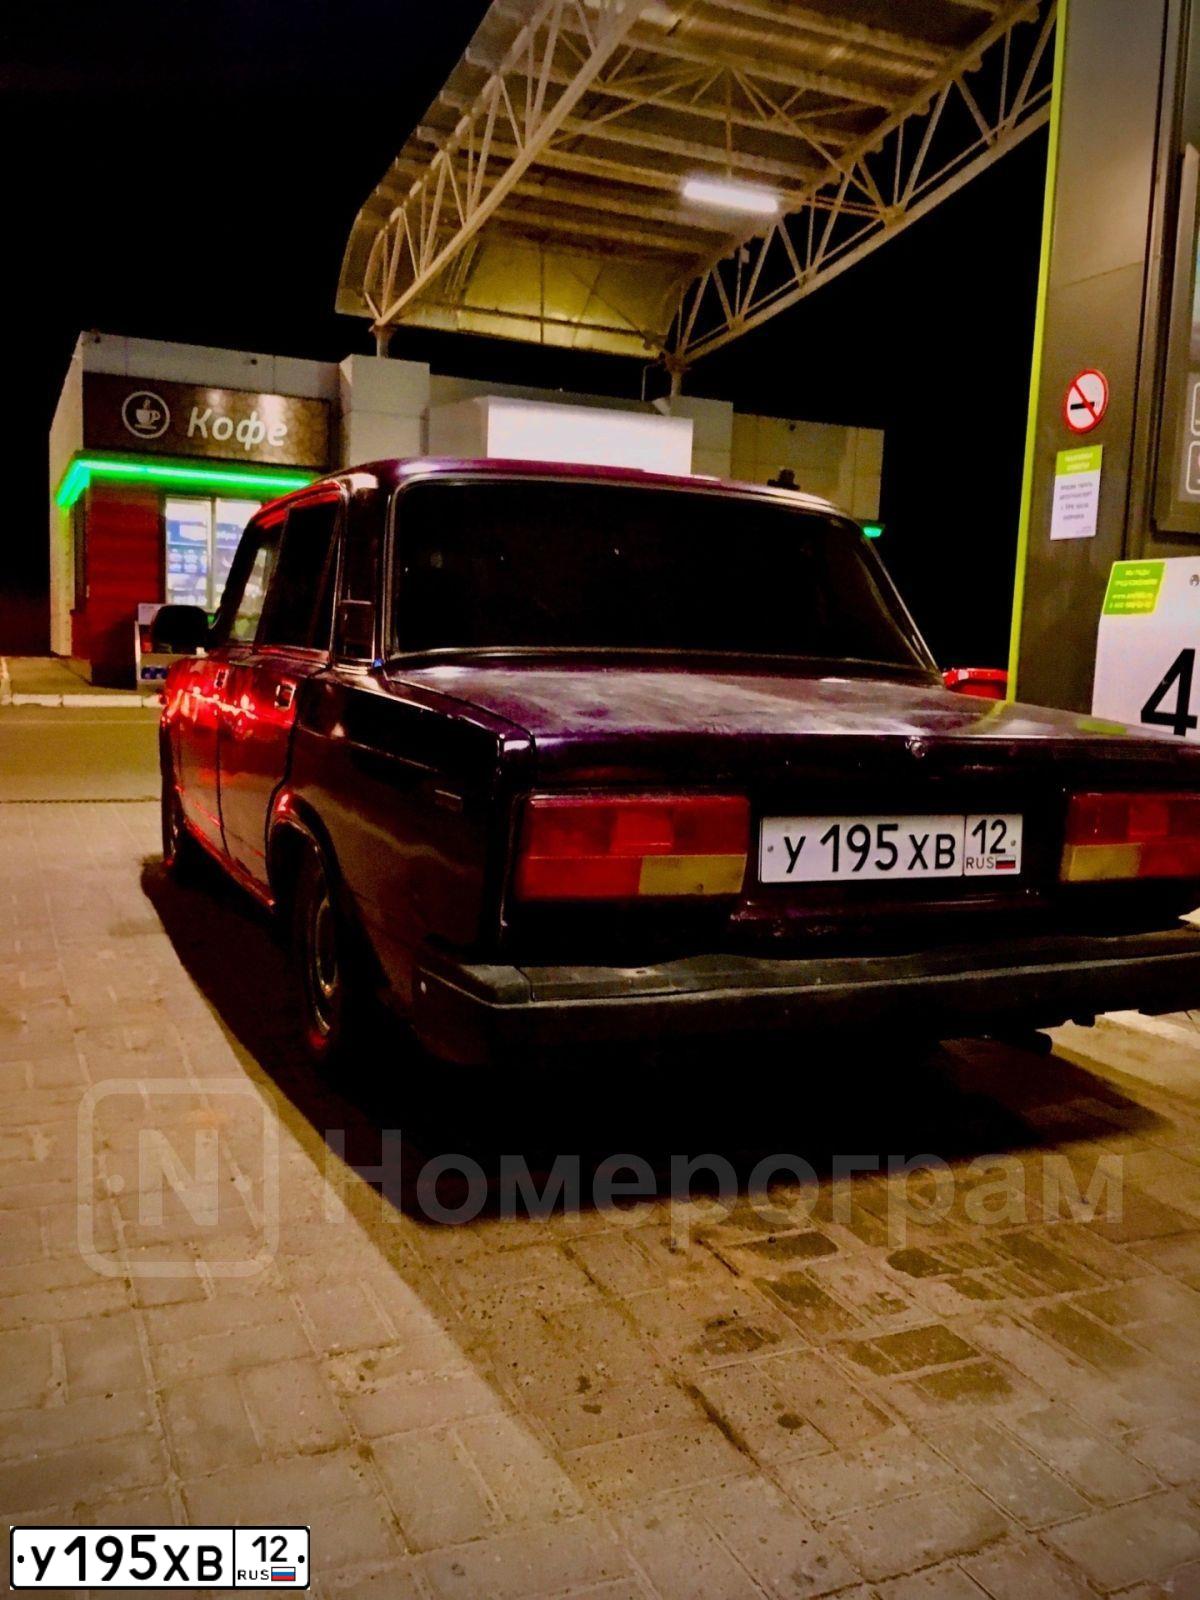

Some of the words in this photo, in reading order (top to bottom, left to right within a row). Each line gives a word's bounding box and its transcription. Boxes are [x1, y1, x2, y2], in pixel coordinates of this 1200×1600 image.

[187, 406, 288, 451] Кофе
[1141, 648, 1198, 736] 4
[971, 819, 1008, 855] 12
[966, 857, 995, 870] RUS
